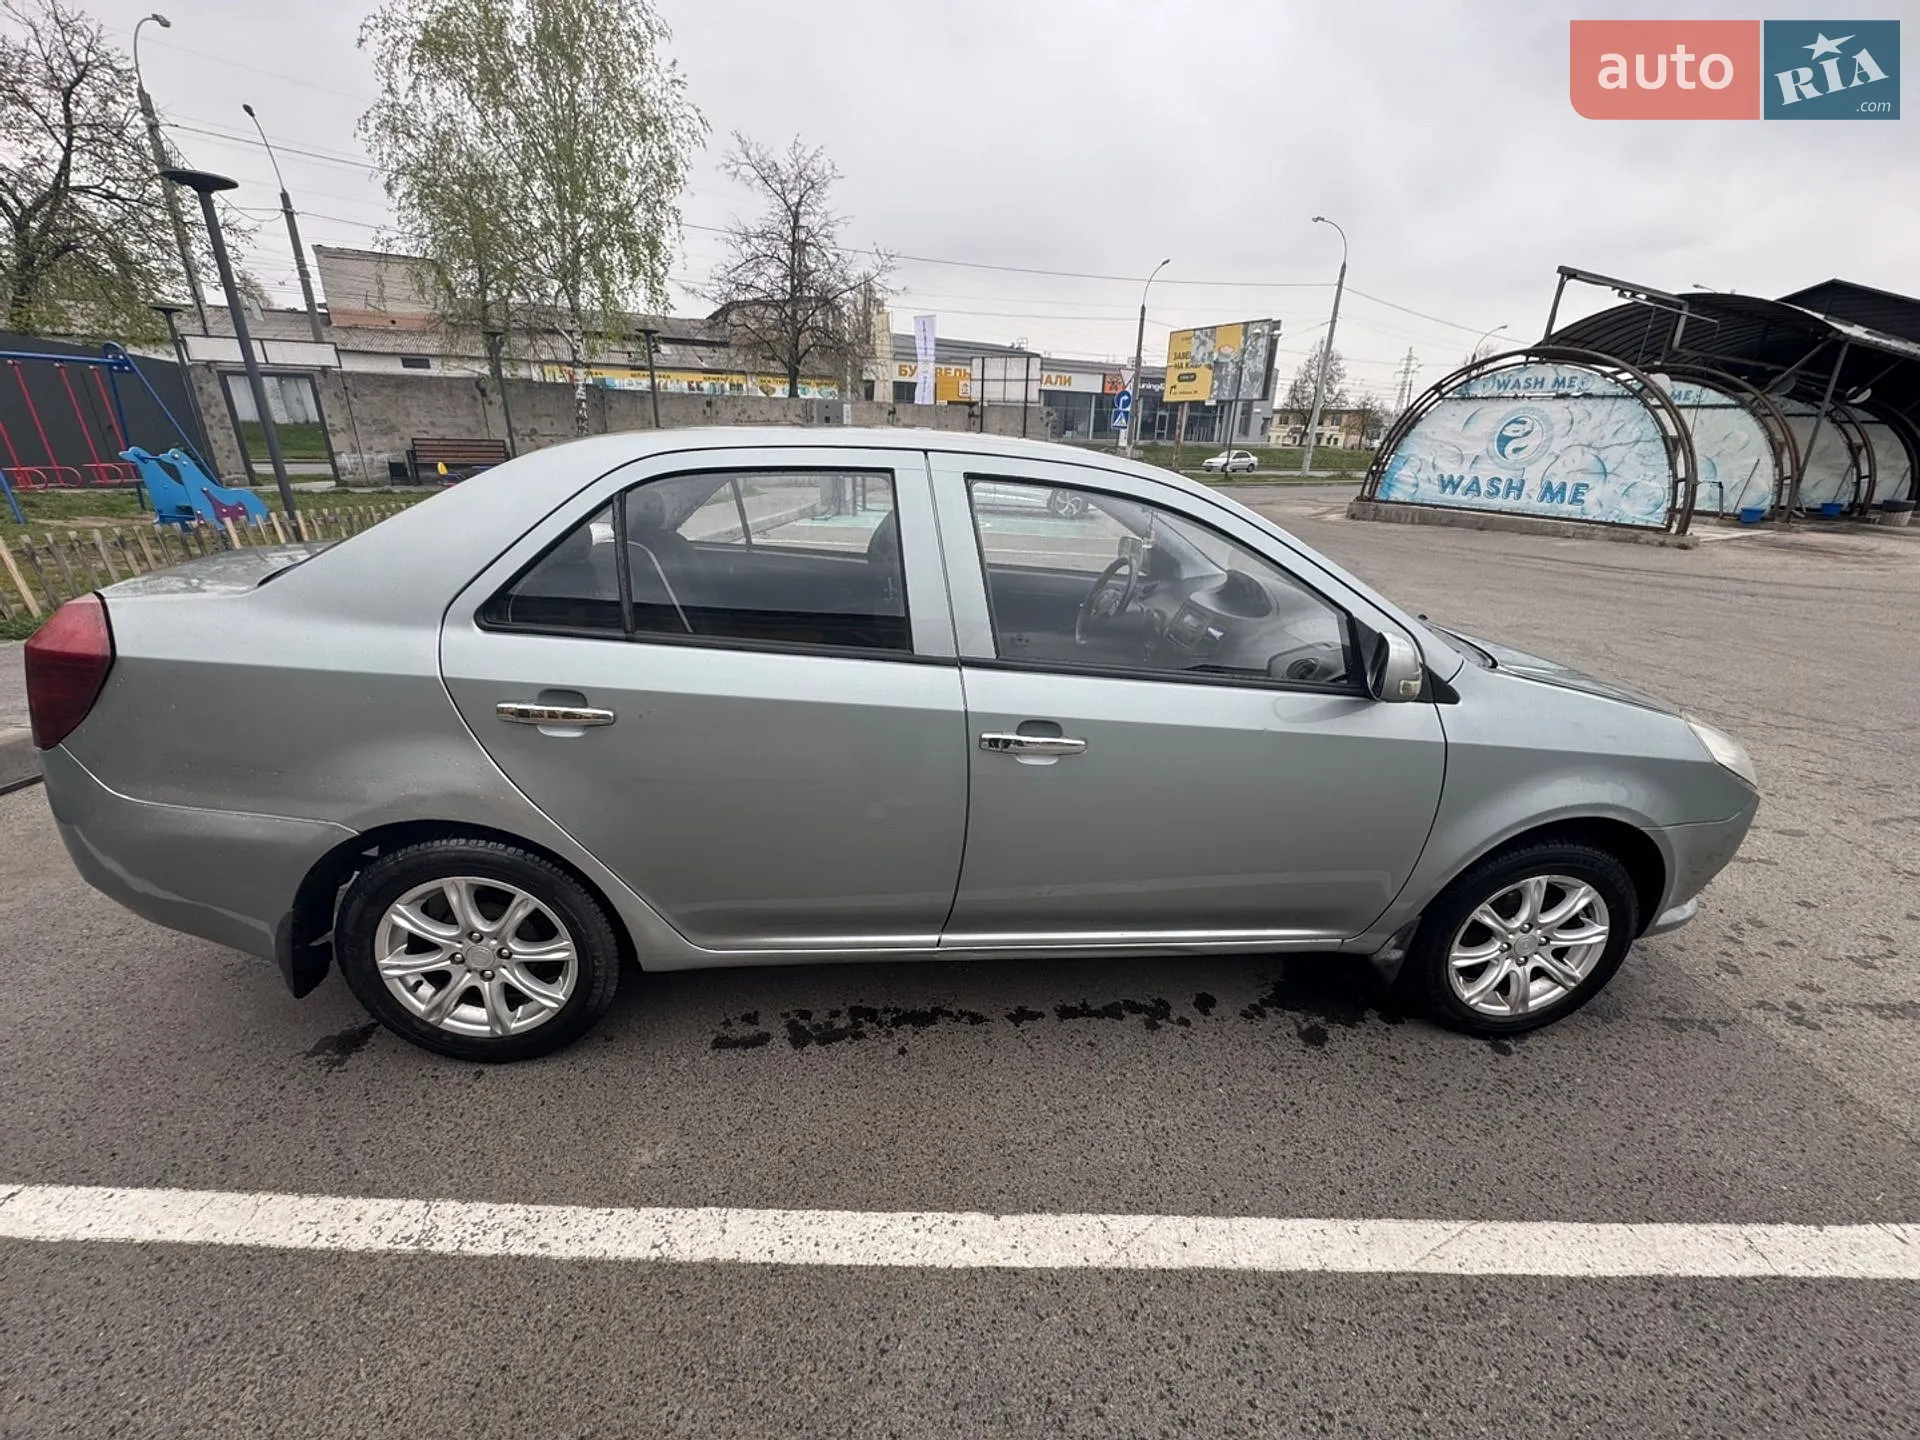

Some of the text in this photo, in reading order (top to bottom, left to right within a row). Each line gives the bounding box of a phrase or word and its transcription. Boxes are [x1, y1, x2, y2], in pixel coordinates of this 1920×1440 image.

[898, 364, 971, 379] БУВЕЛЬ
[1496, 375, 1579, 391] WASH ME
[1437, 473, 1590, 506] WASH ME
